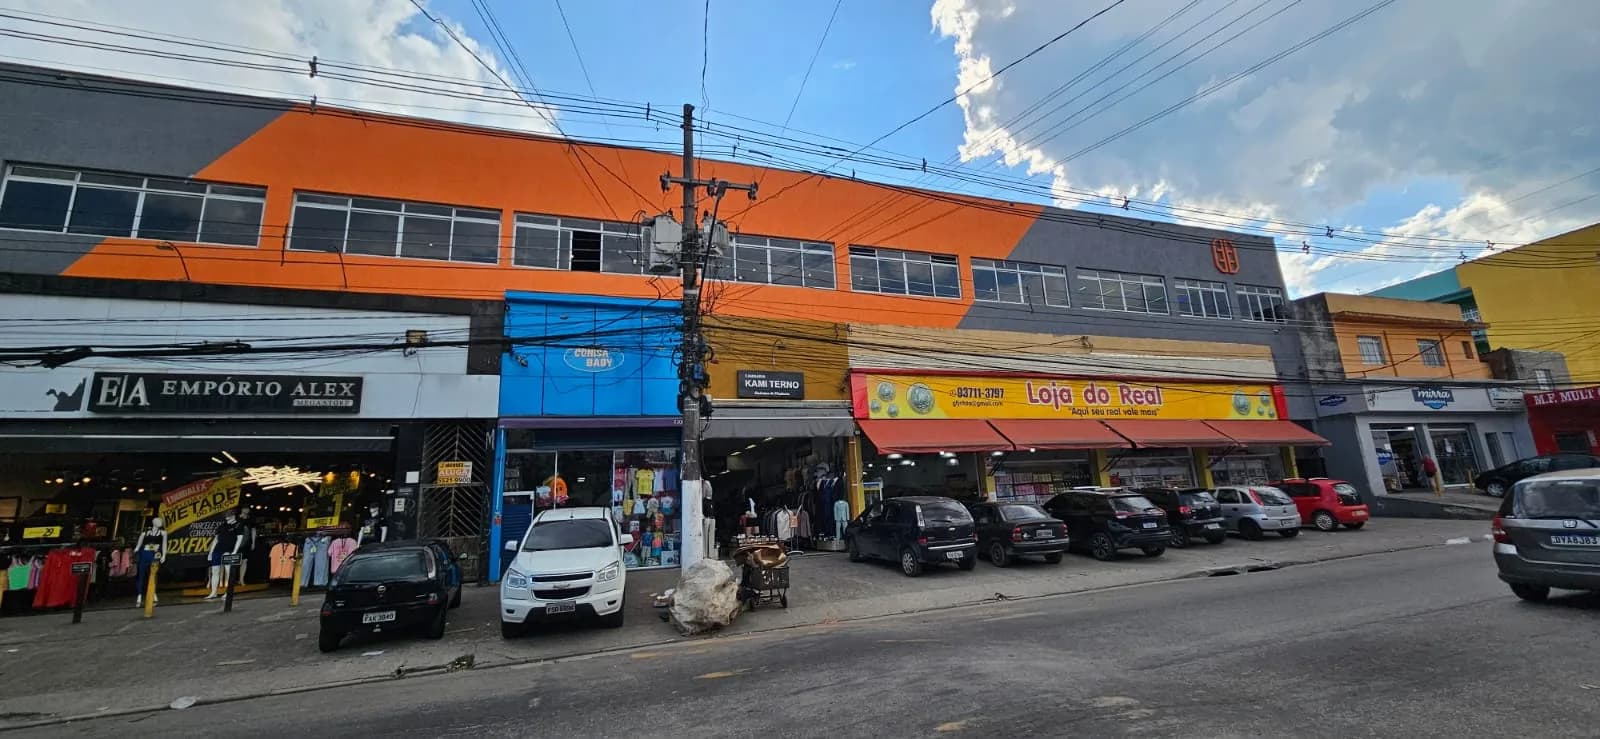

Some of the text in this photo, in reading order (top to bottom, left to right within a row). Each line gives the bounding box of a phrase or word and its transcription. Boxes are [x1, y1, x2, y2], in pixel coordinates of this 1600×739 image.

[160, 377, 282, 396] EMPÓRIO
[291, 382, 355, 397] ALEX
[745, 379, 800, 389] KAMI TERNO
[1026, 381, 1163, 410] Loja do Real
[1560, 389, 1594, 402] MULT
[1091, 408, 1104, 416] seu
[1107, 408, 1121, 416] real
[1123, 408, 1138, 416] vale
[163, 486, 238, 528] METADE
